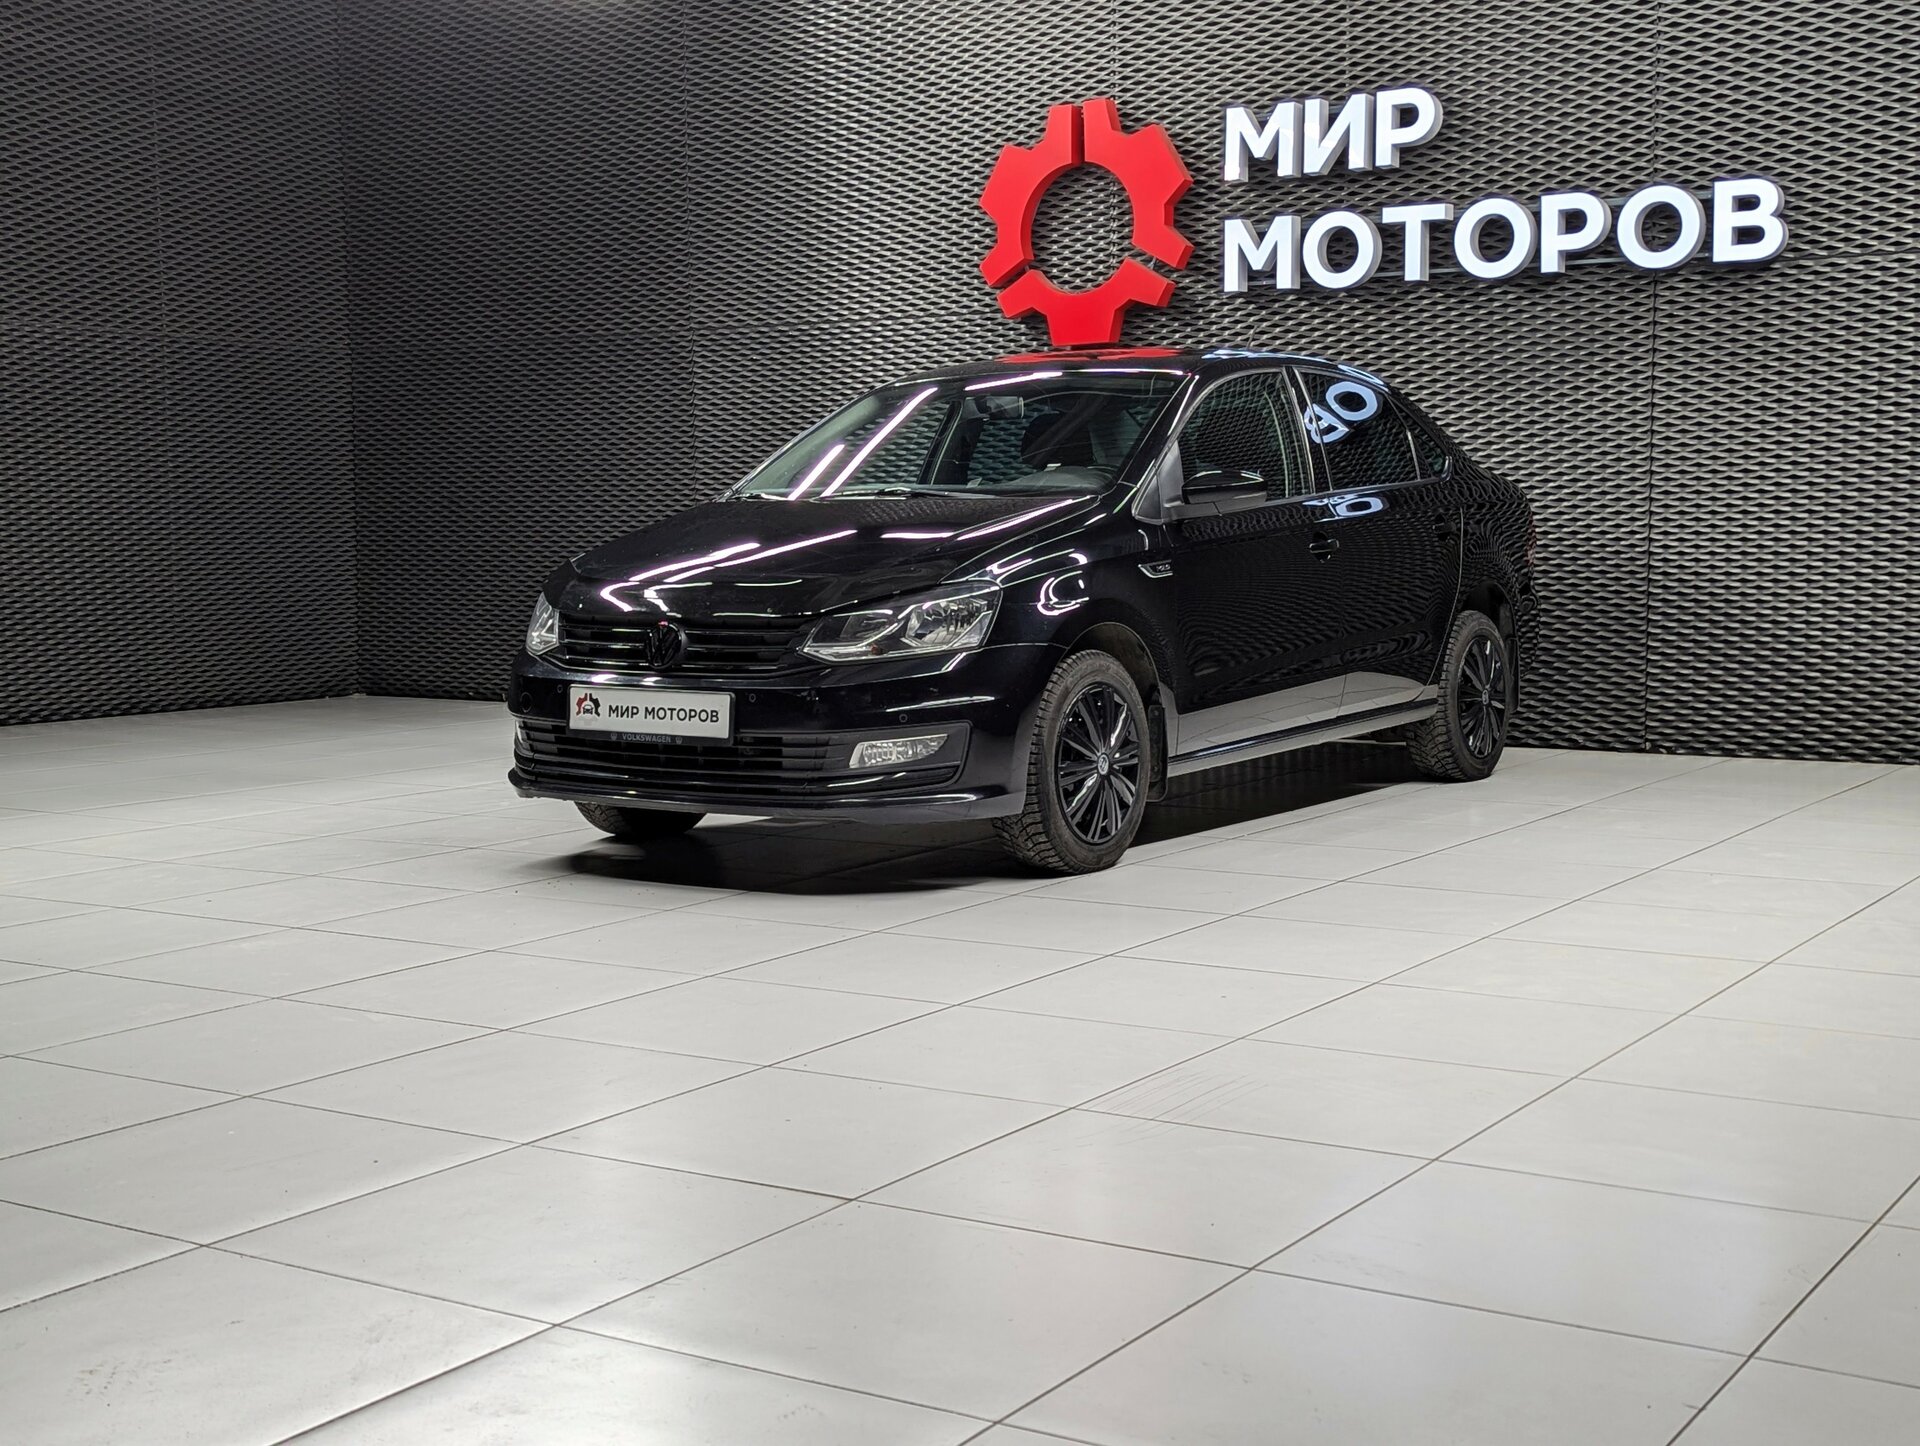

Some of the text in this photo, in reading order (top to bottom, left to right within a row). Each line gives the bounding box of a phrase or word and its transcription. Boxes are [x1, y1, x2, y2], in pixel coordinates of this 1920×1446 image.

[1224, 87, 1443, 182] МИР
[1224, 178, 1789, 292] МОТОРОВ
[608, 704, 720, 723] МИР МОТОРОВ
[622, 733, 671, 743] VOLKSWAGEN
